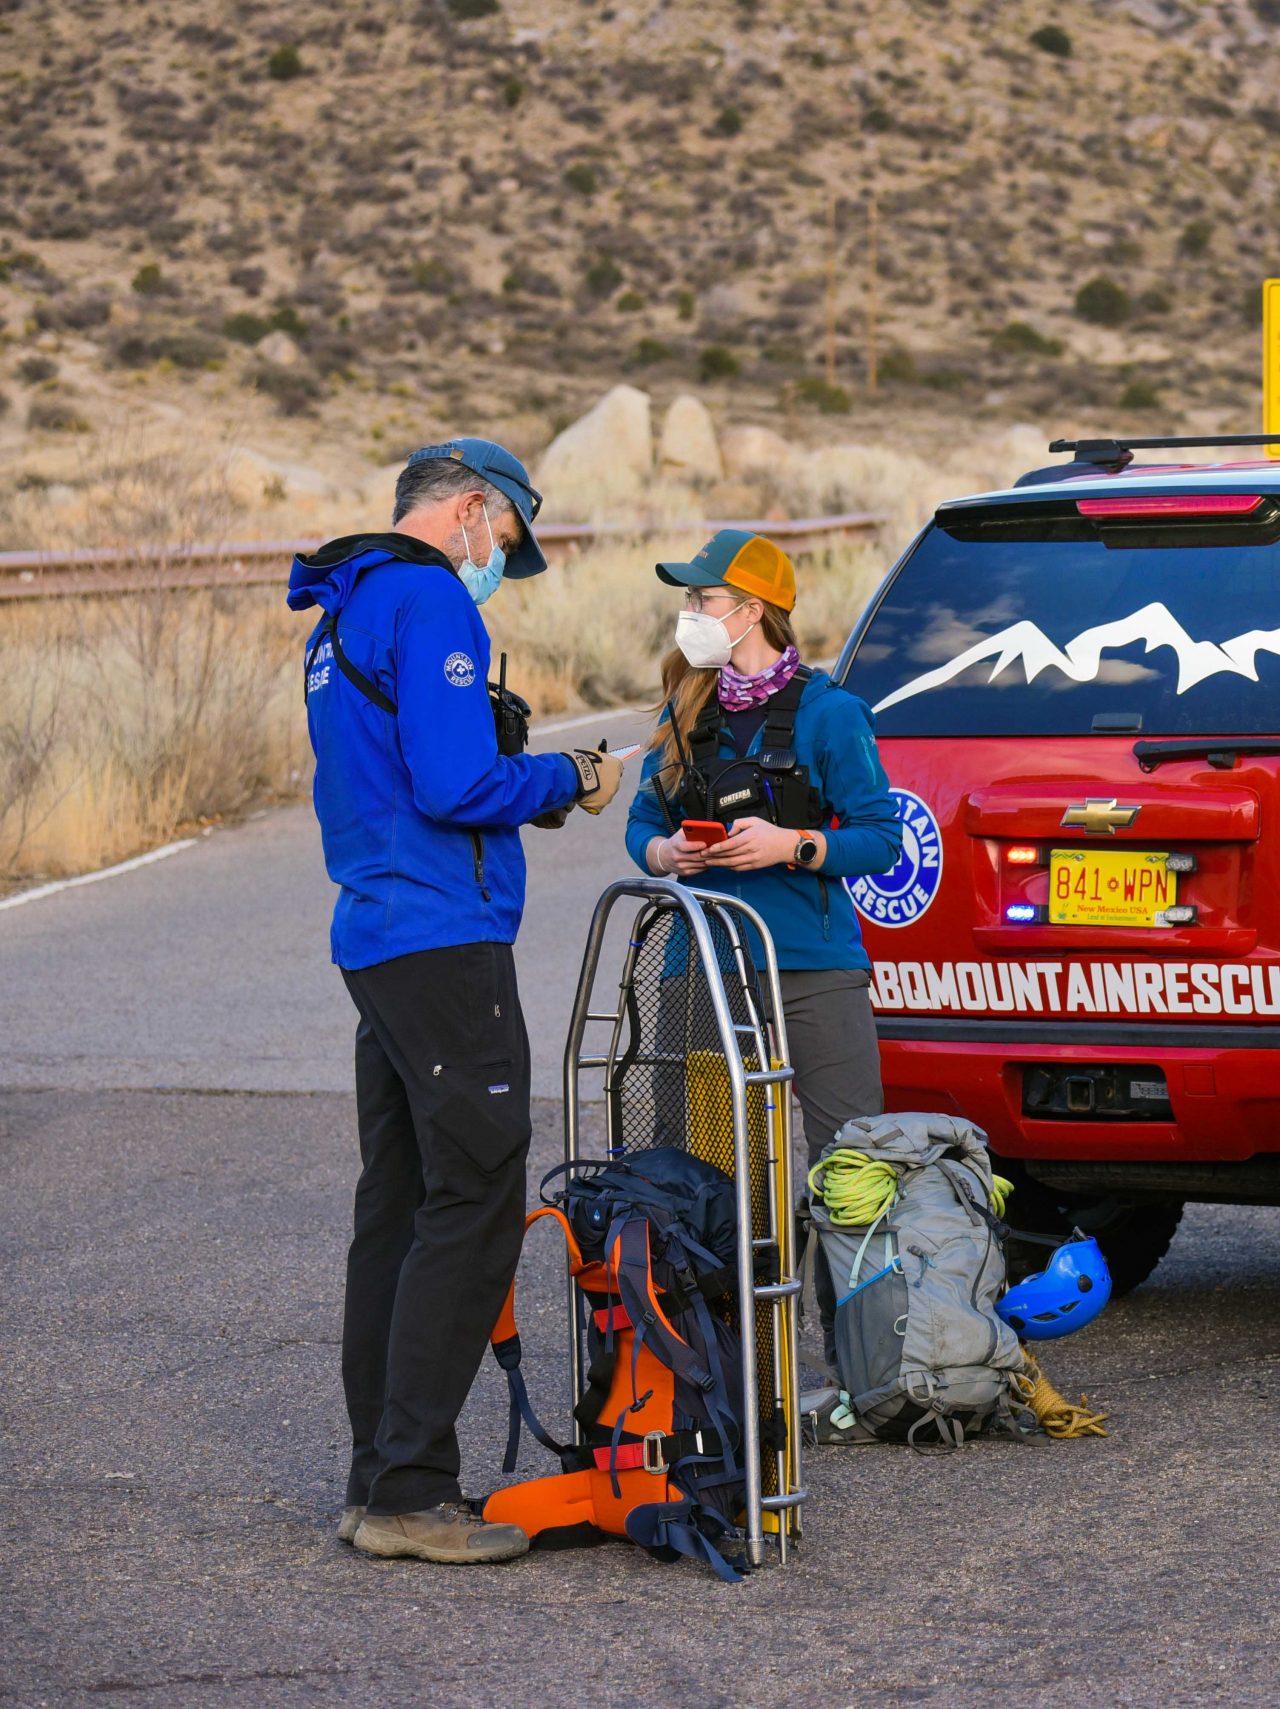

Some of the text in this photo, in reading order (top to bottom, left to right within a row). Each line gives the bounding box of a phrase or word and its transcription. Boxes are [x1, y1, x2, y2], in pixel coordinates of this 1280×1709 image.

[576, 754, 592, 779] PETZL
[720, 788, 752, 806] CONTERRA
[1057, 867, 1168, 903] 841 WPN
[851, 877, 929, 920] RESCUE
[1077, 904, 1149, 915] New Mexico USA
